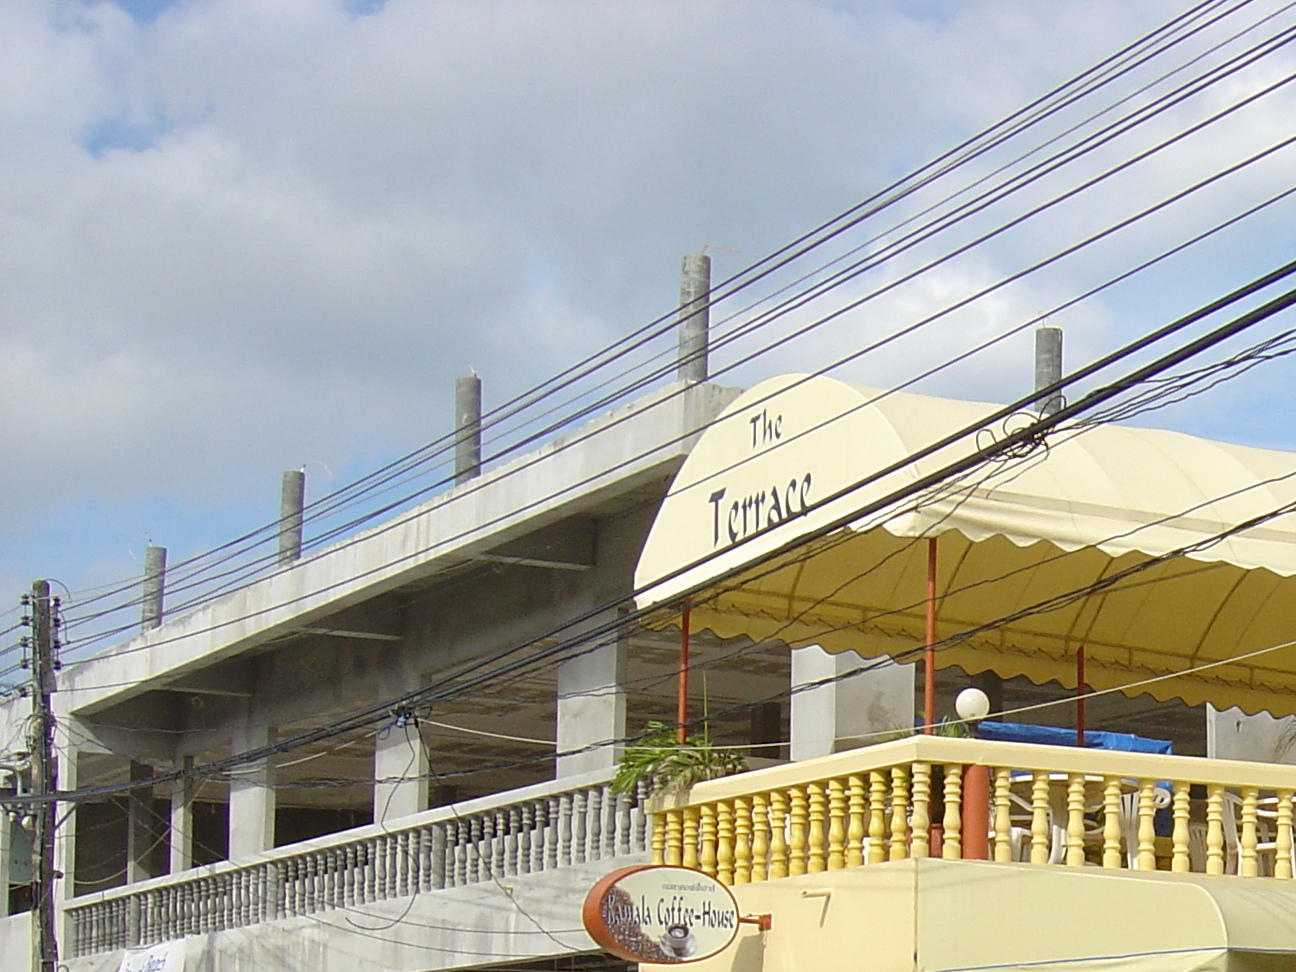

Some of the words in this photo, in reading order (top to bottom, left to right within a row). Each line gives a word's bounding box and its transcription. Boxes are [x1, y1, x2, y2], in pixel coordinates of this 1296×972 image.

[749, 408, 784, 450] The
[708, 471, 813, 549] Terrace
[607, 894, 652, 926] Kamala
[656, 895, 735, 929] Coffee-House
